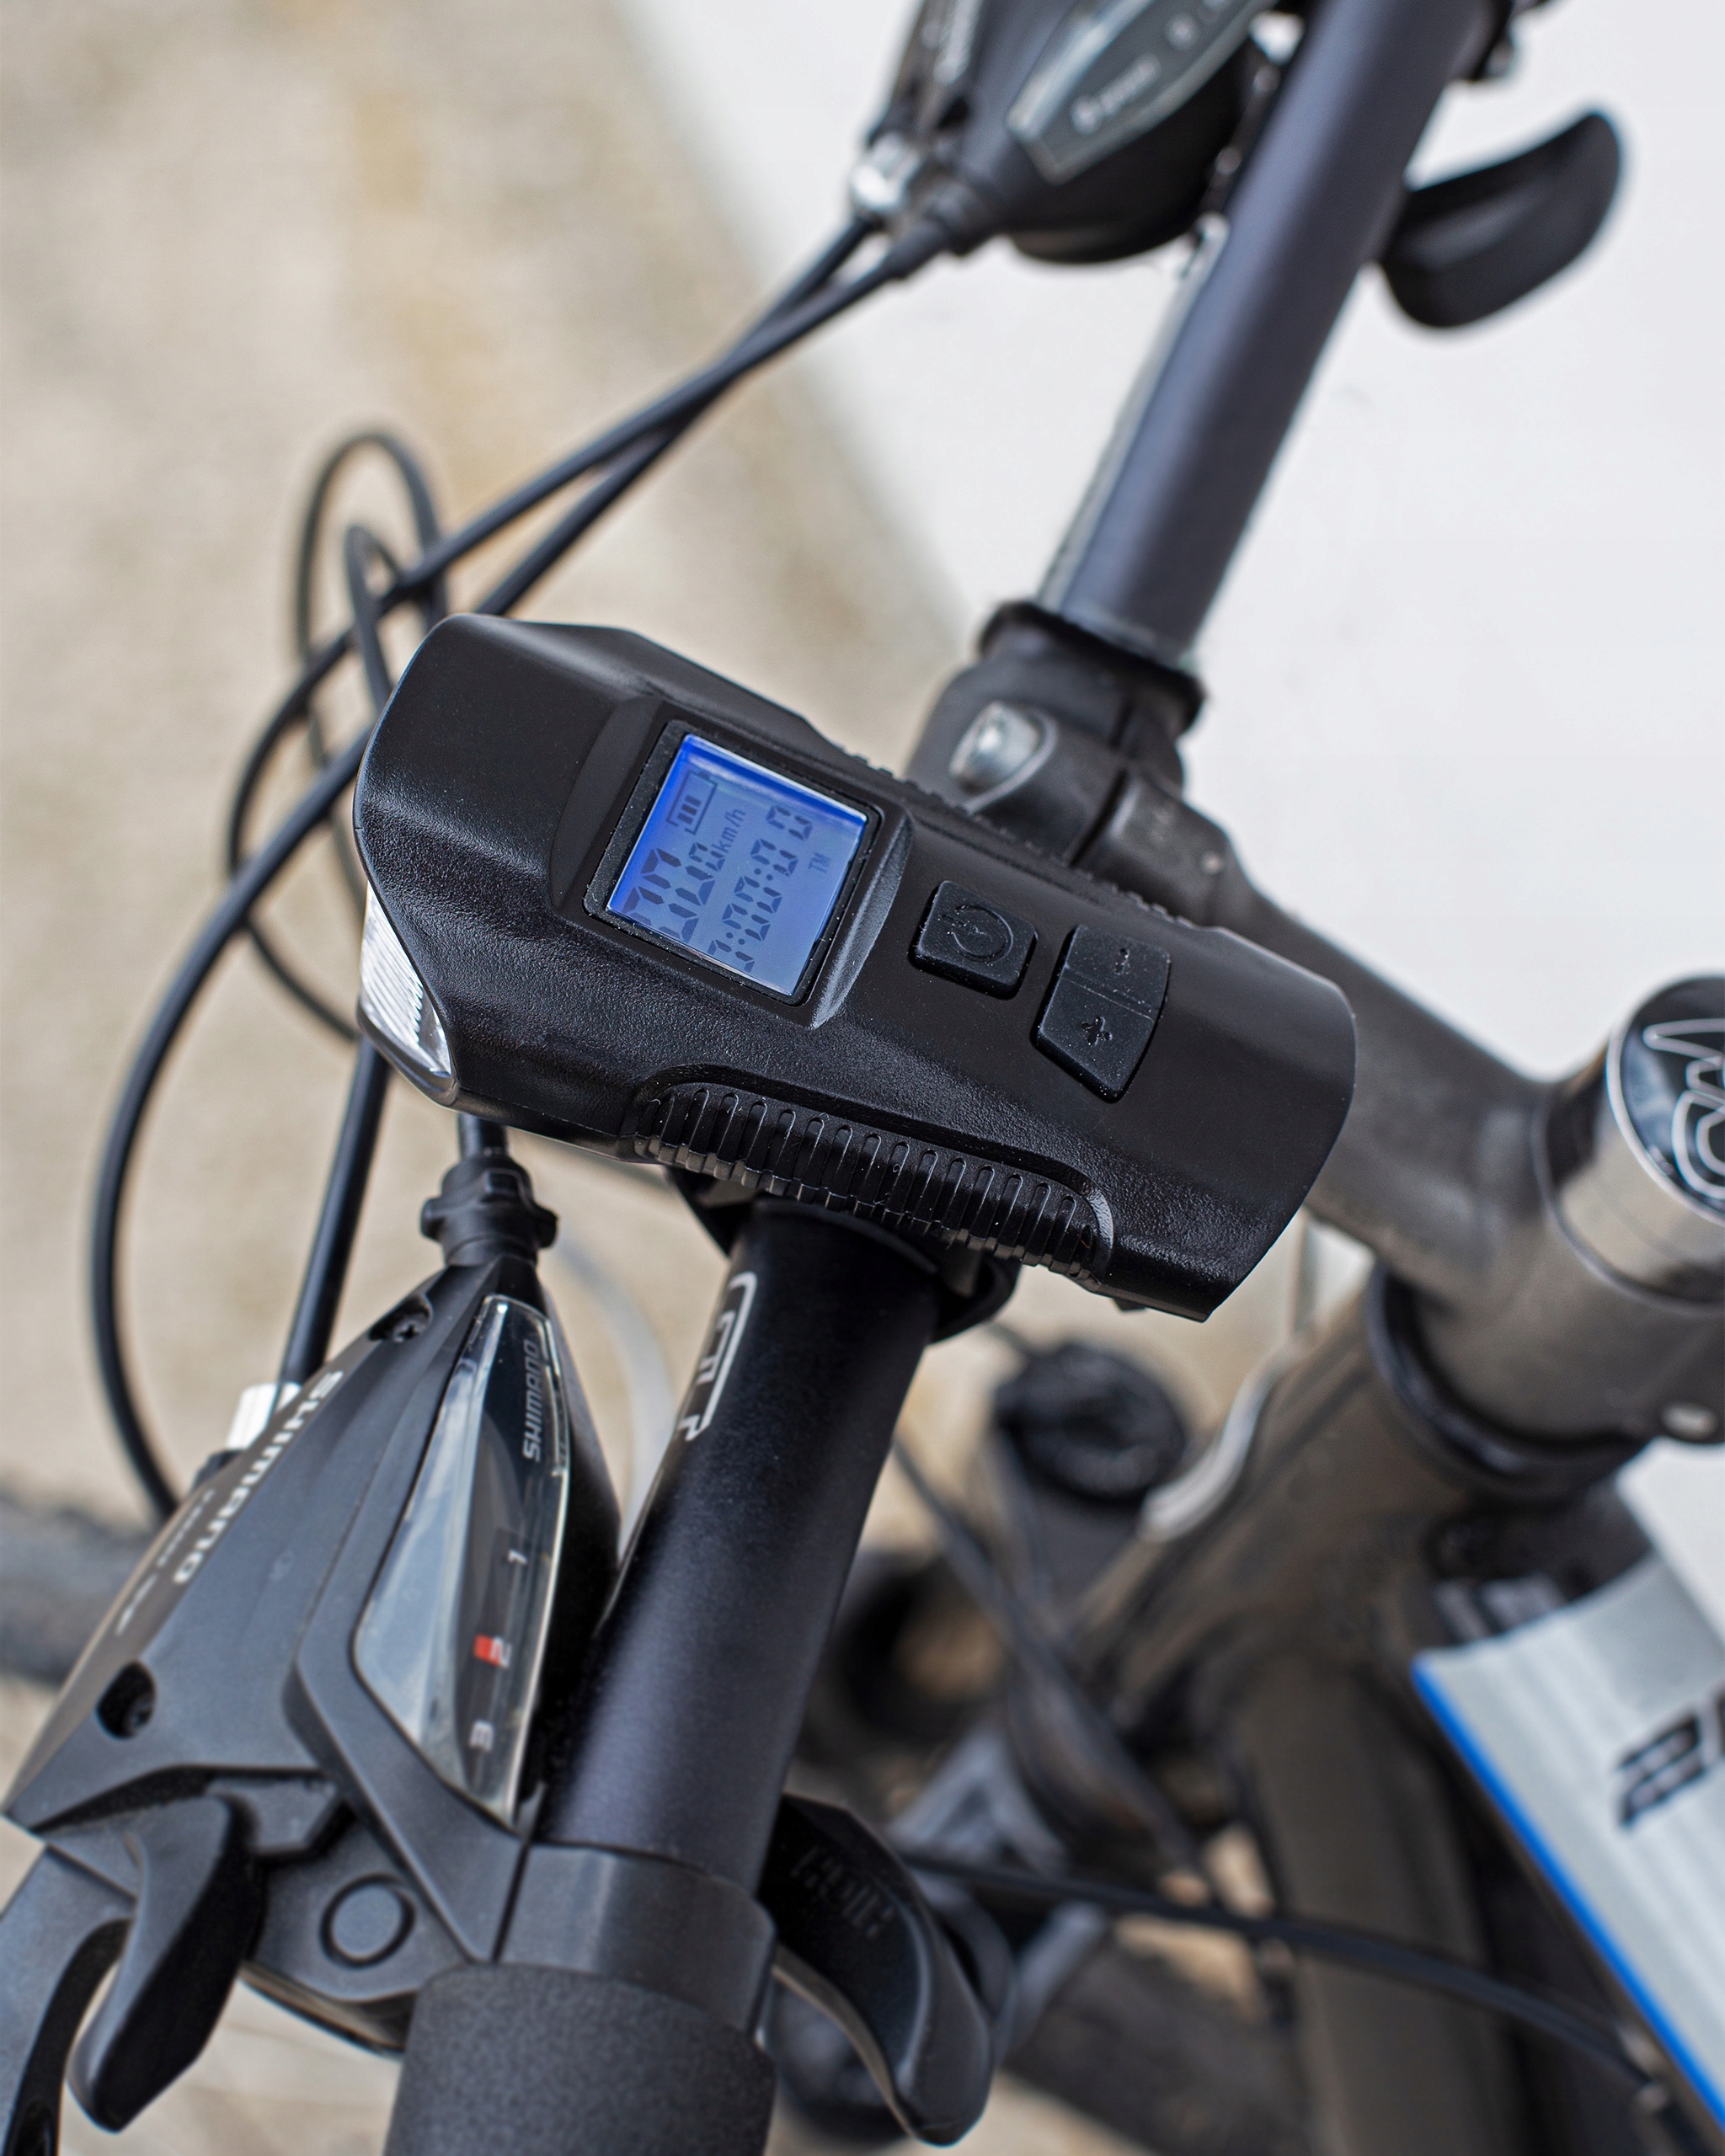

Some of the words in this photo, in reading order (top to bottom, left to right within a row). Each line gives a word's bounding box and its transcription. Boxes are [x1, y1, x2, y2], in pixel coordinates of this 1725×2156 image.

[717, 808, 747, 854] km/h
[523, 1340, 542, 1462] SHIMANO
[173, 1370, 344, 1584] SHIMANO
